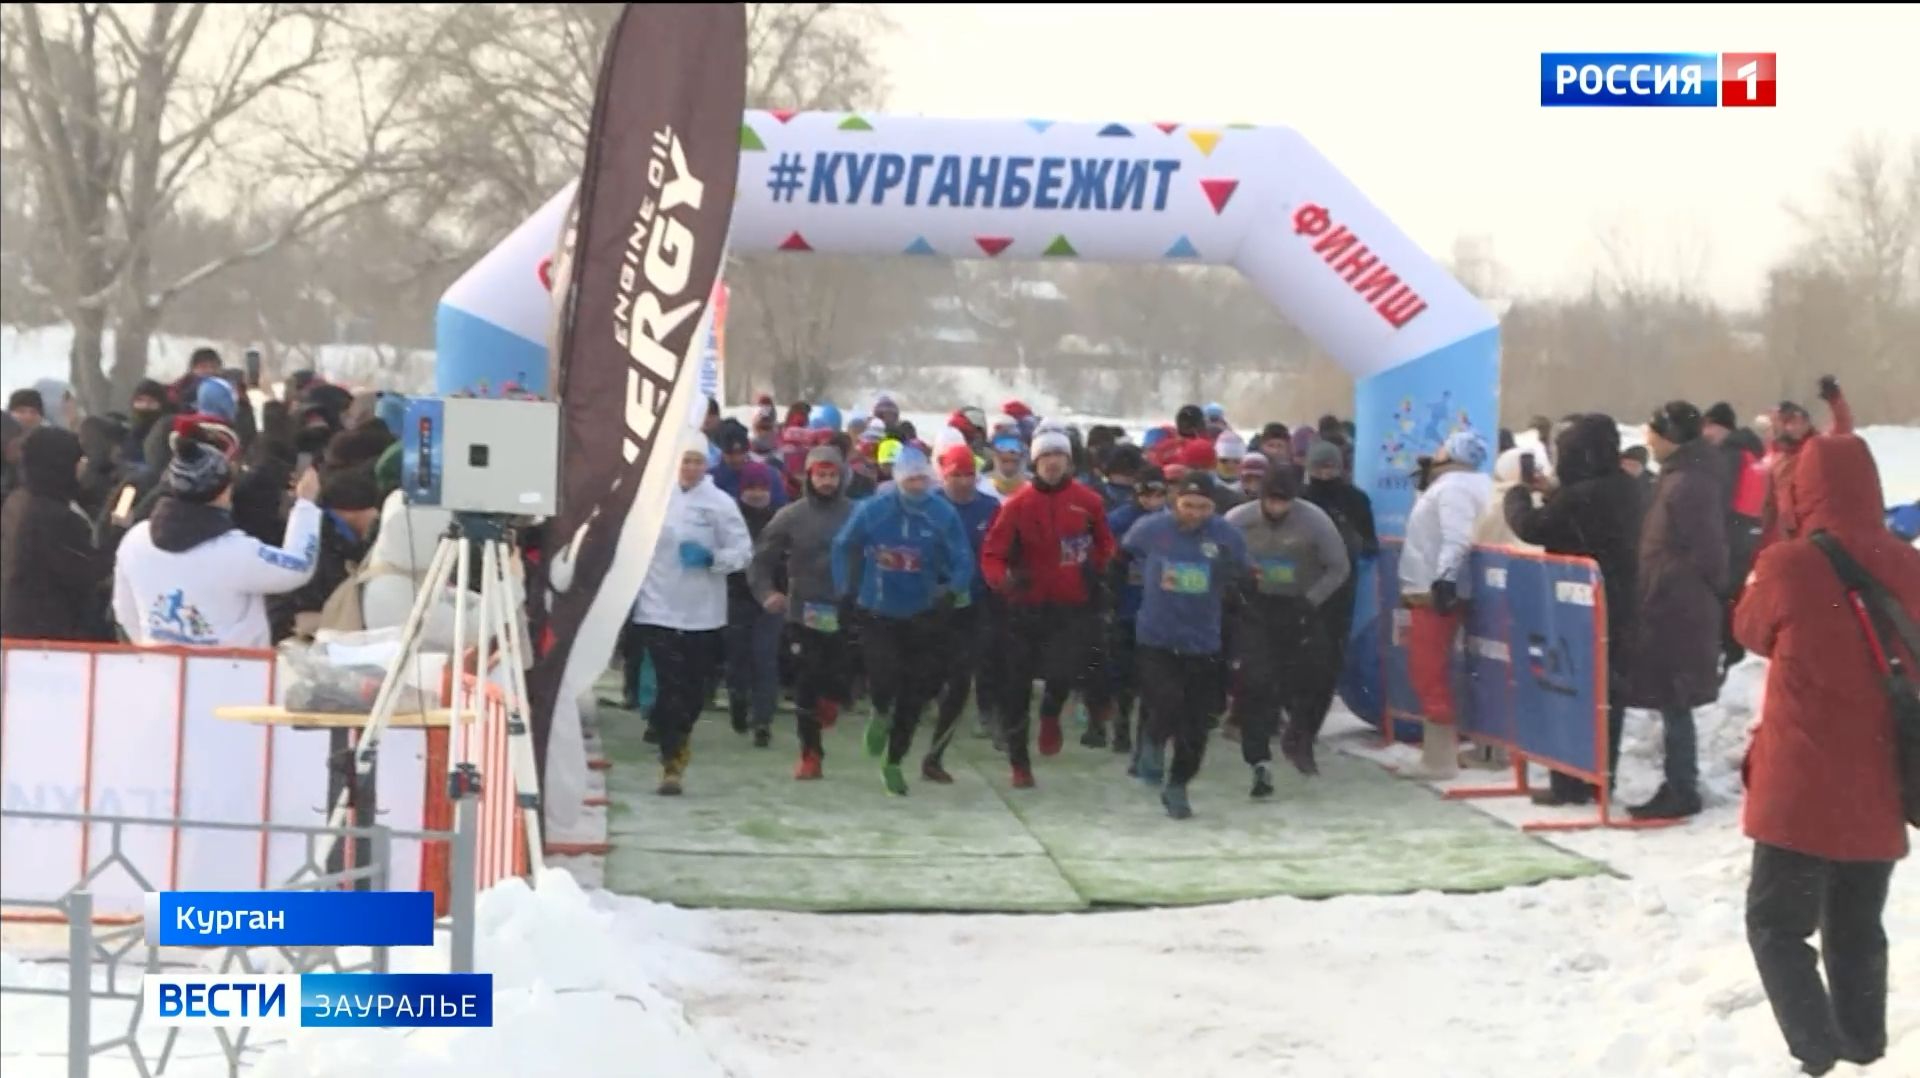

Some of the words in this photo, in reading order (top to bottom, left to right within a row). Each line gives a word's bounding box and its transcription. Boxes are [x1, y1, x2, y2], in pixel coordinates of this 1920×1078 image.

[613, 195, 657, 348] ENGINE
[647, 124, 673, 190] OIL
[767, 151, 1181, 211] #КУРГАНБЕЖИТ
[1294, 204, 1428, 329] ФИНИШ
